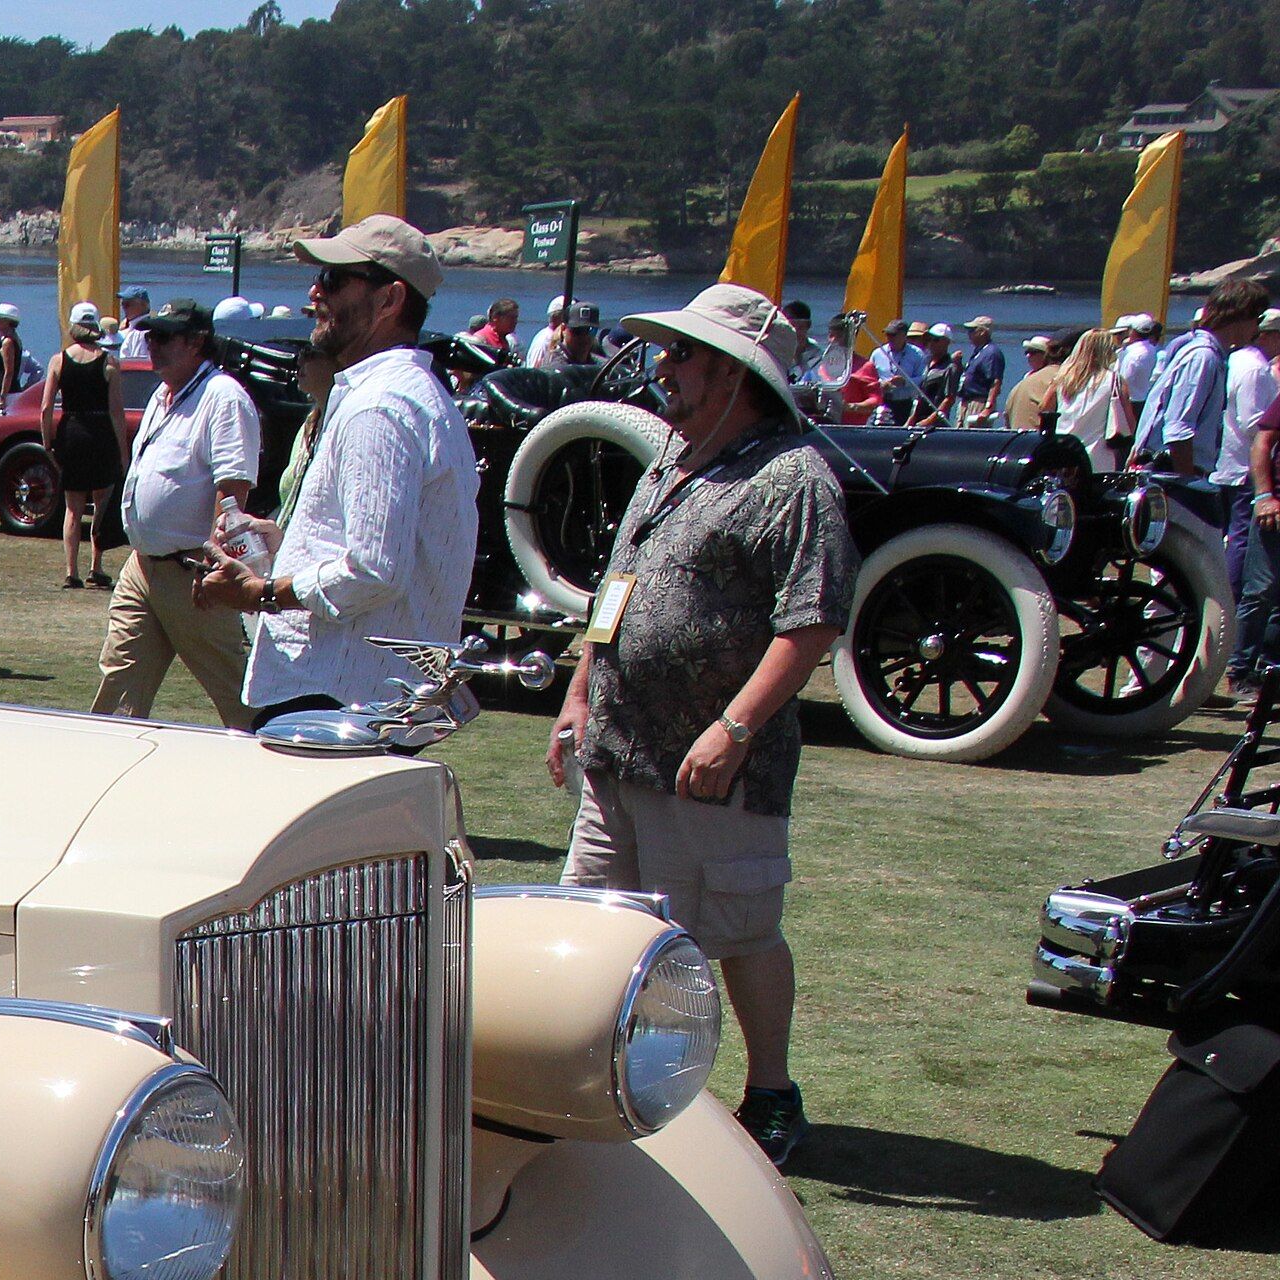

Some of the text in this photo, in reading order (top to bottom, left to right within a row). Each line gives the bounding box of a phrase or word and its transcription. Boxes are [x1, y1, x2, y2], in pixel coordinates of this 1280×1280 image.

[531, 220, 563, 235] Class O-1
[533, 237, 557, 248] Postwar
[211, 246, 224, 255] Class
